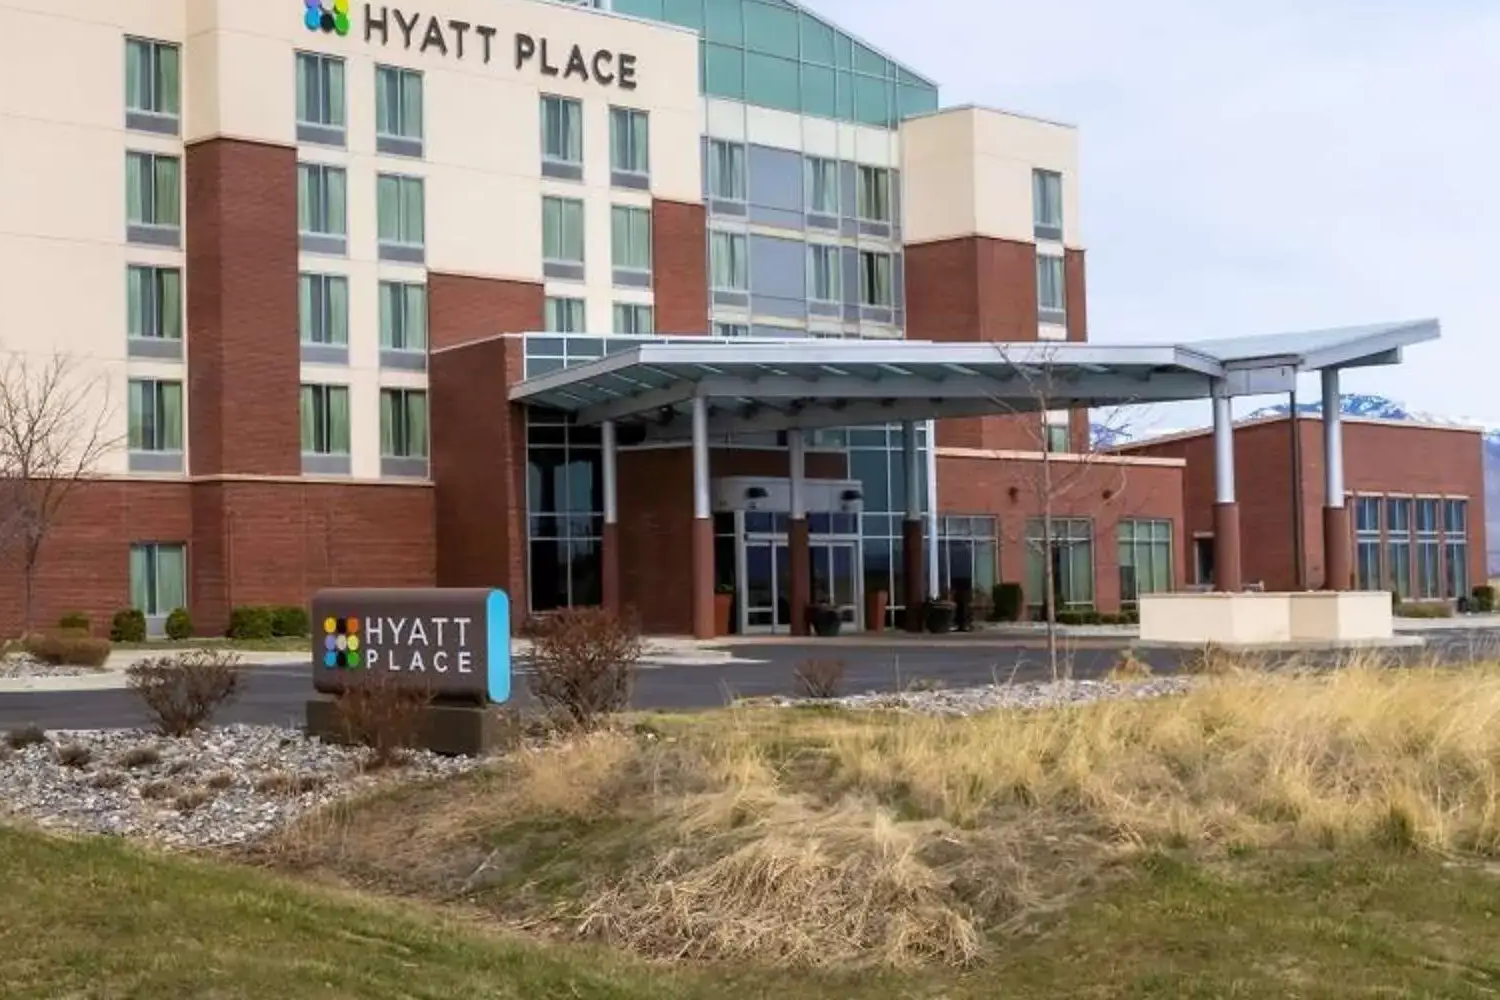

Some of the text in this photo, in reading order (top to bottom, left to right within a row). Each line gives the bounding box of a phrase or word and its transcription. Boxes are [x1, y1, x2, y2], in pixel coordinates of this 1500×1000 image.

[363, 3, 638, 90] HYATT PLACE
[365, 617, 472, 647] HYATT
[366, 650, 473, 673] PLACE
